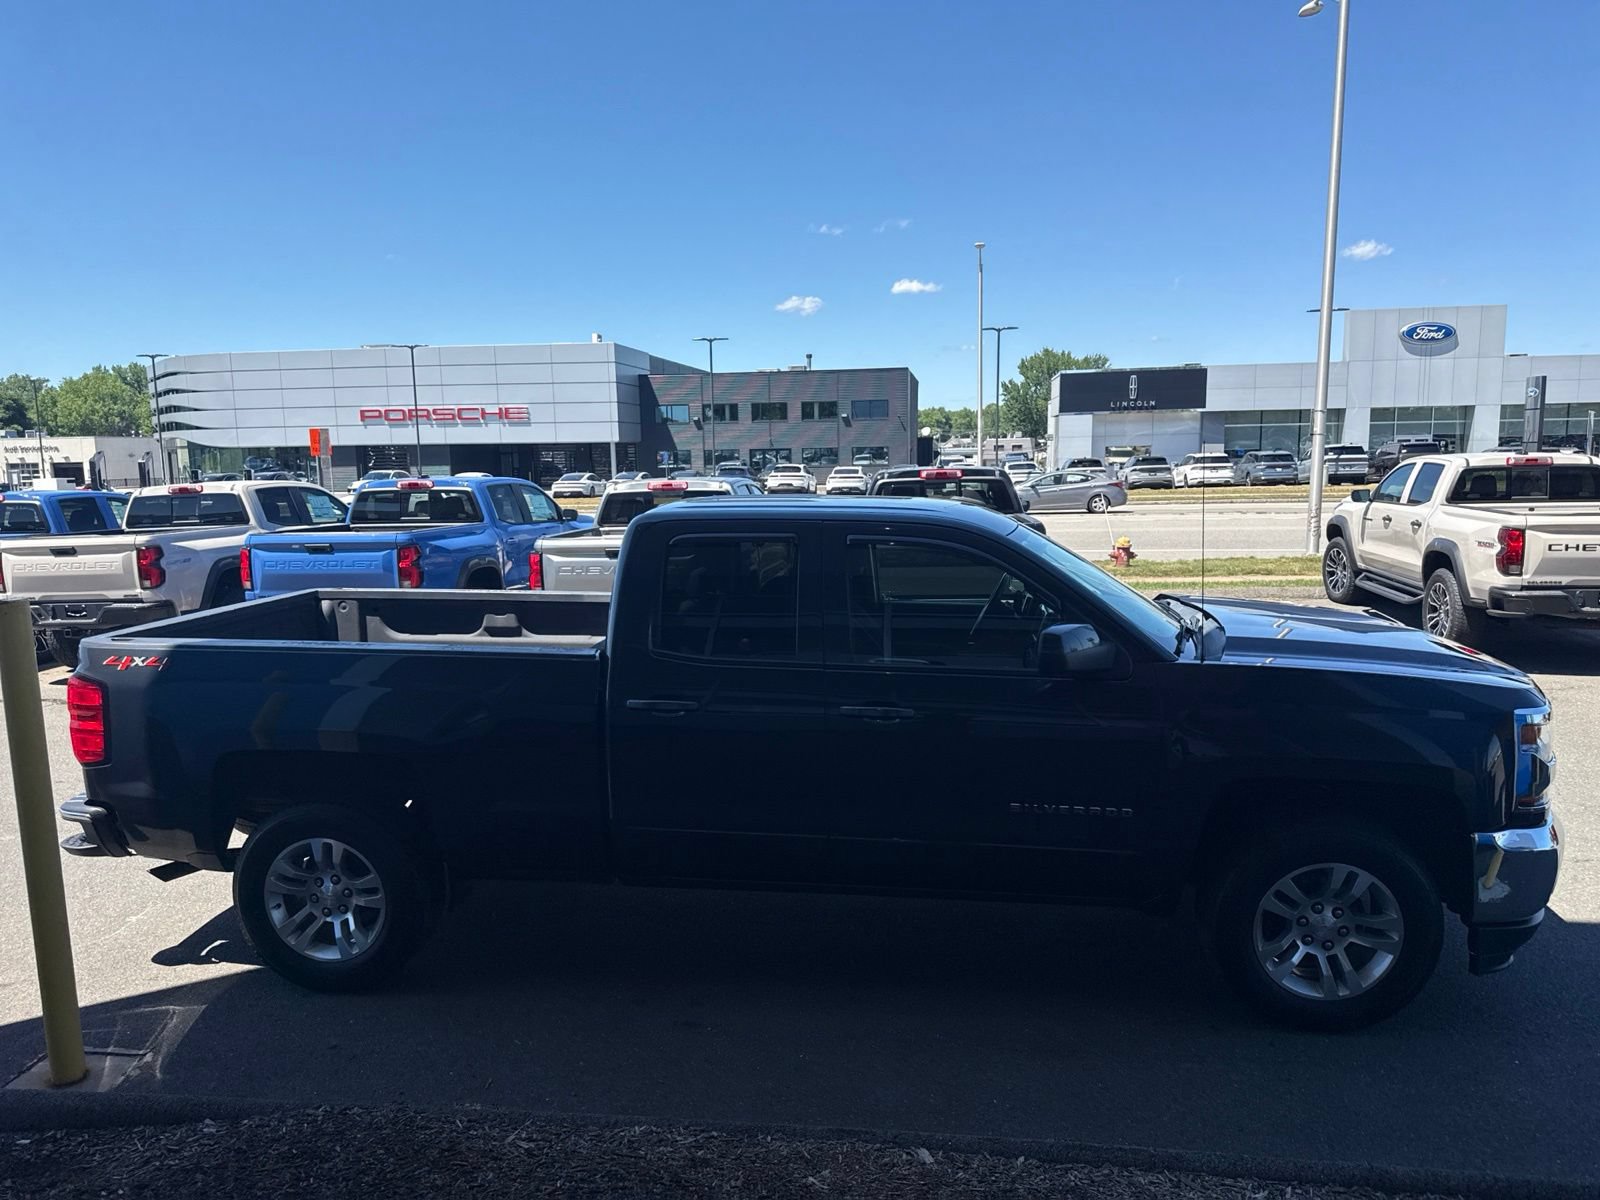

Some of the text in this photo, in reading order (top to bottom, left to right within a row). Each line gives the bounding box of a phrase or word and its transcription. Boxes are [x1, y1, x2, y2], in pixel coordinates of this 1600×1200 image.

[1412, 326, 1446, 340] Ford
[1110, 400, 1156, 408] LINCOLN
[359, 406, 530, 422] PORSCHE
[1547, 543, 1600, 552] CHE
[12, 560, 120, 573] CHEVROLET
[263, 559, 378, 570] CHEVROLET
[1008, 802, 1134, 817] SILVERADO
